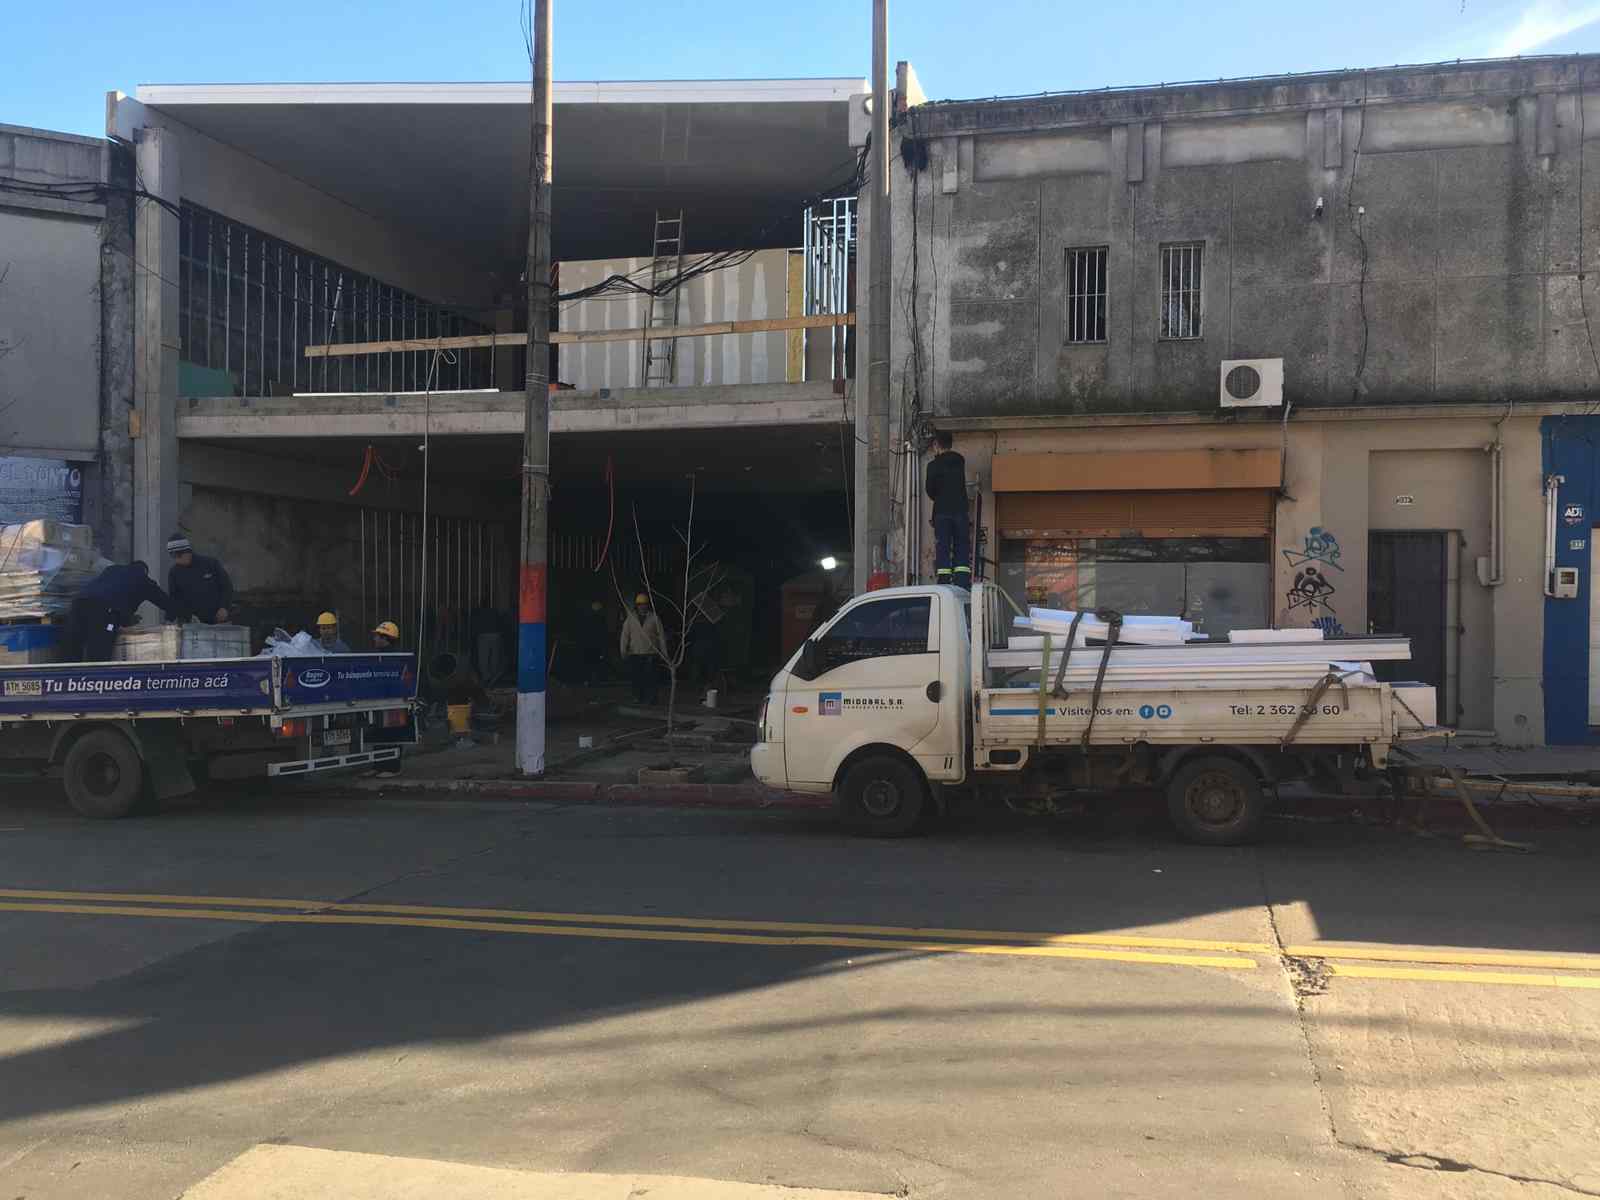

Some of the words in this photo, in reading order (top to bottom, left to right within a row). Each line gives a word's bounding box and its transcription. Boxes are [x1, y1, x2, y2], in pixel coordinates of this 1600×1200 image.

[45, 679, 63, 692] Tu
[67, 676, 142, 694] búsqueda
[146, 675, 200, 690] termina
[204, 672, 229, 688] acá
[1115, 707, 1134, 716] en:
[1229, 704, 1254, 715] Tel:
[1256, 705, 1265, 715] 2
[1270, 705, 1296, 715] 362
[1322, 704, 1340, 715] 60
